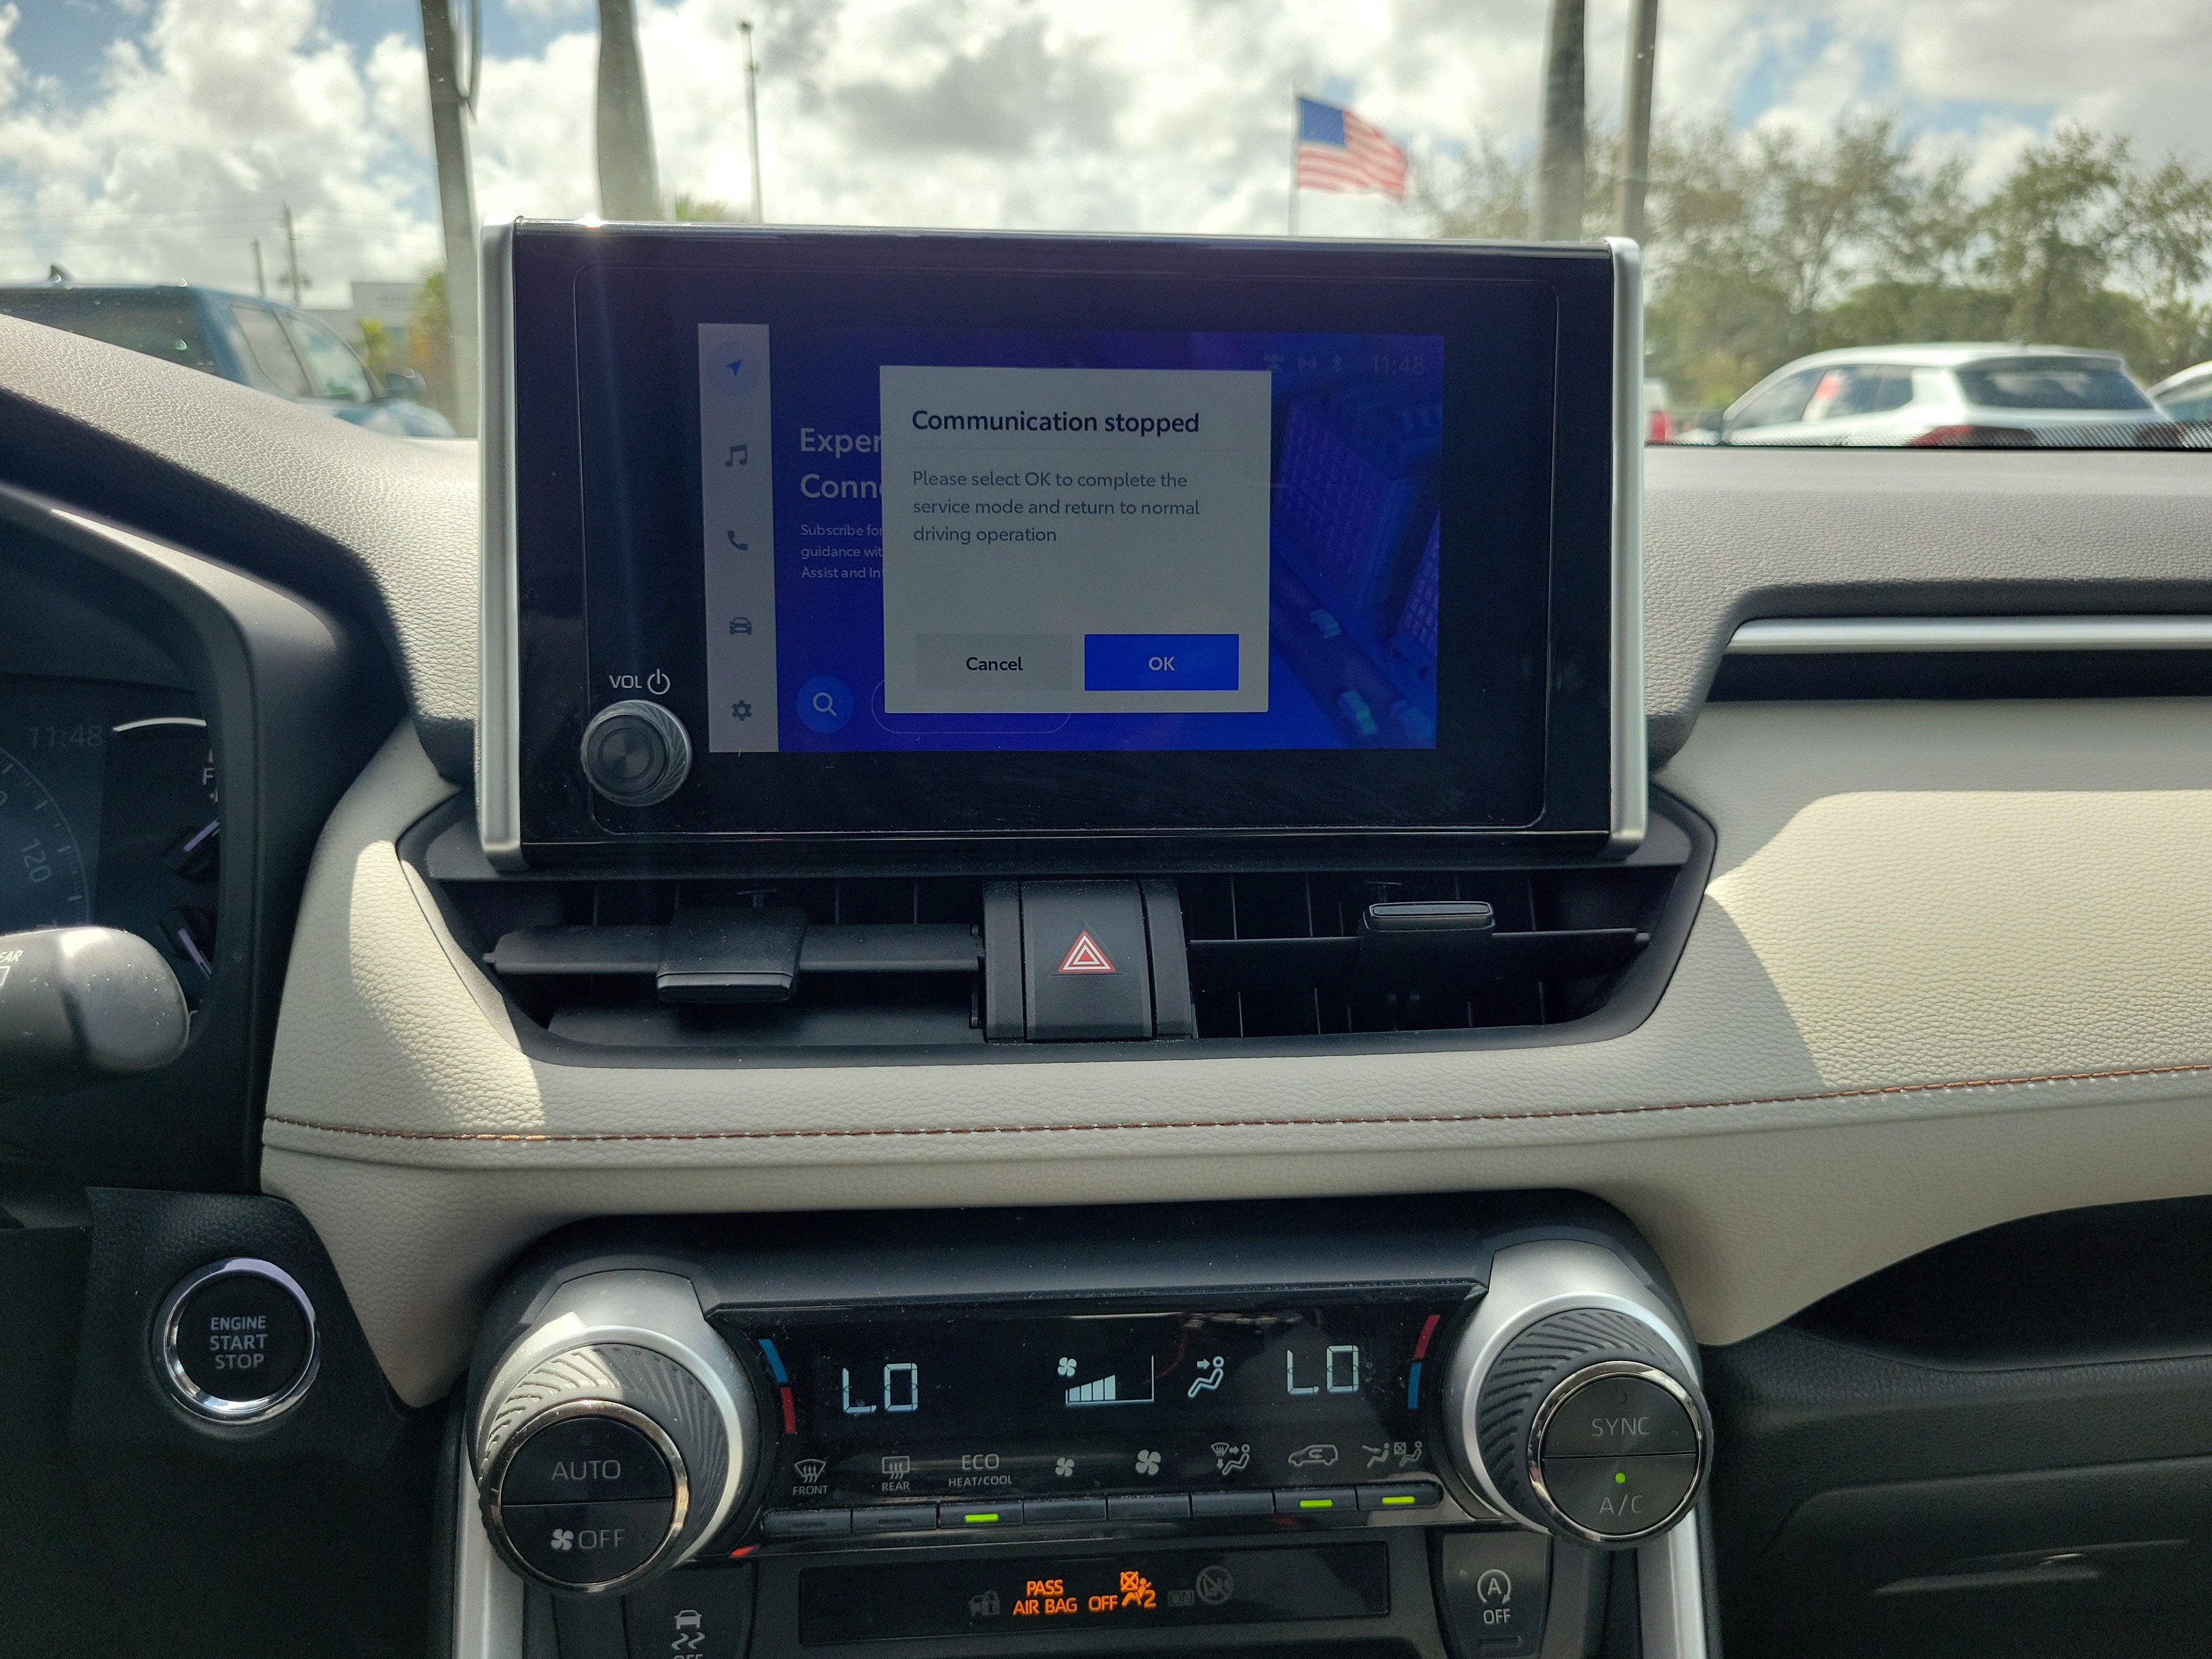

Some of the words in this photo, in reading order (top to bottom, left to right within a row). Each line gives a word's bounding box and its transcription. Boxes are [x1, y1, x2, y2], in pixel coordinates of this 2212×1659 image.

[912, 410, 1097, 431] Communication
[1104, 413, 1199, 437] stopped
[801, 474, 883, 498] Conn
[913, 471, 967, 486] Please
[972, 471, 1020, 486] select
[1025, 472, 1051, 486] OK
[1056, 473, 1073, 487] to
[1077, 472, 1156, 491] complete
[1160, 472, 1187, 487] the
[913, 499, 970, 514] service
[975, 499, 1024, 514] mode
[1029, 499, 1060, 514] and
[1065, 501, 1115, 515] return
[1120, 501, 1137, 515] to
[1141, 500, 1200, 515] normal
[801, 524, 864, 536] Subscribe
[913, 526, 971, 545] driving
[976, 527, 1057, 545] operation
[801, 546, 861, 560] guidance
[802, 567, 838, 578] Assist
[841, 567, 866, 578] and
[966, 656, 1024, 672] Cancel
[1148, 657, 1175, 672] OK
[610, 675, 642, 689] VOL
[29, 725, 104, 748] 11:48
[22, 838, 52, 883] 120
[211, 1315, 267, 1330] ENGINE
[209, 1334, 268, 1350] START
[215, 1353, 264, 1369] STOP
[1286, 1345, 1359, 1395] LO
[842, 1362, 918, 1414] LO
[1592, 1417, 1651, 1437] SYNC
[552, 1459, 622, 1481] AUTO
[962, 1453, 1000, 1471] ECO
[793, 1485, 828, 1496] FRONT
[882, 1481, 910, 1492] REAR
[949, 1475, 1012, 1488] HEAT/COOL
[1599, 1494, 1644, 1517] A/C
[579, 1528, 626, 1549] OFF
[1026, 1578, 1064, 1596] PASS
[1013, 1599, 1040, 1616] AIR
[1045, 1597, 1077, 1615] BAG
[1088, 1594, 1118, 1612] OFF
[1483, 1608, 1511, 1624] OFF
